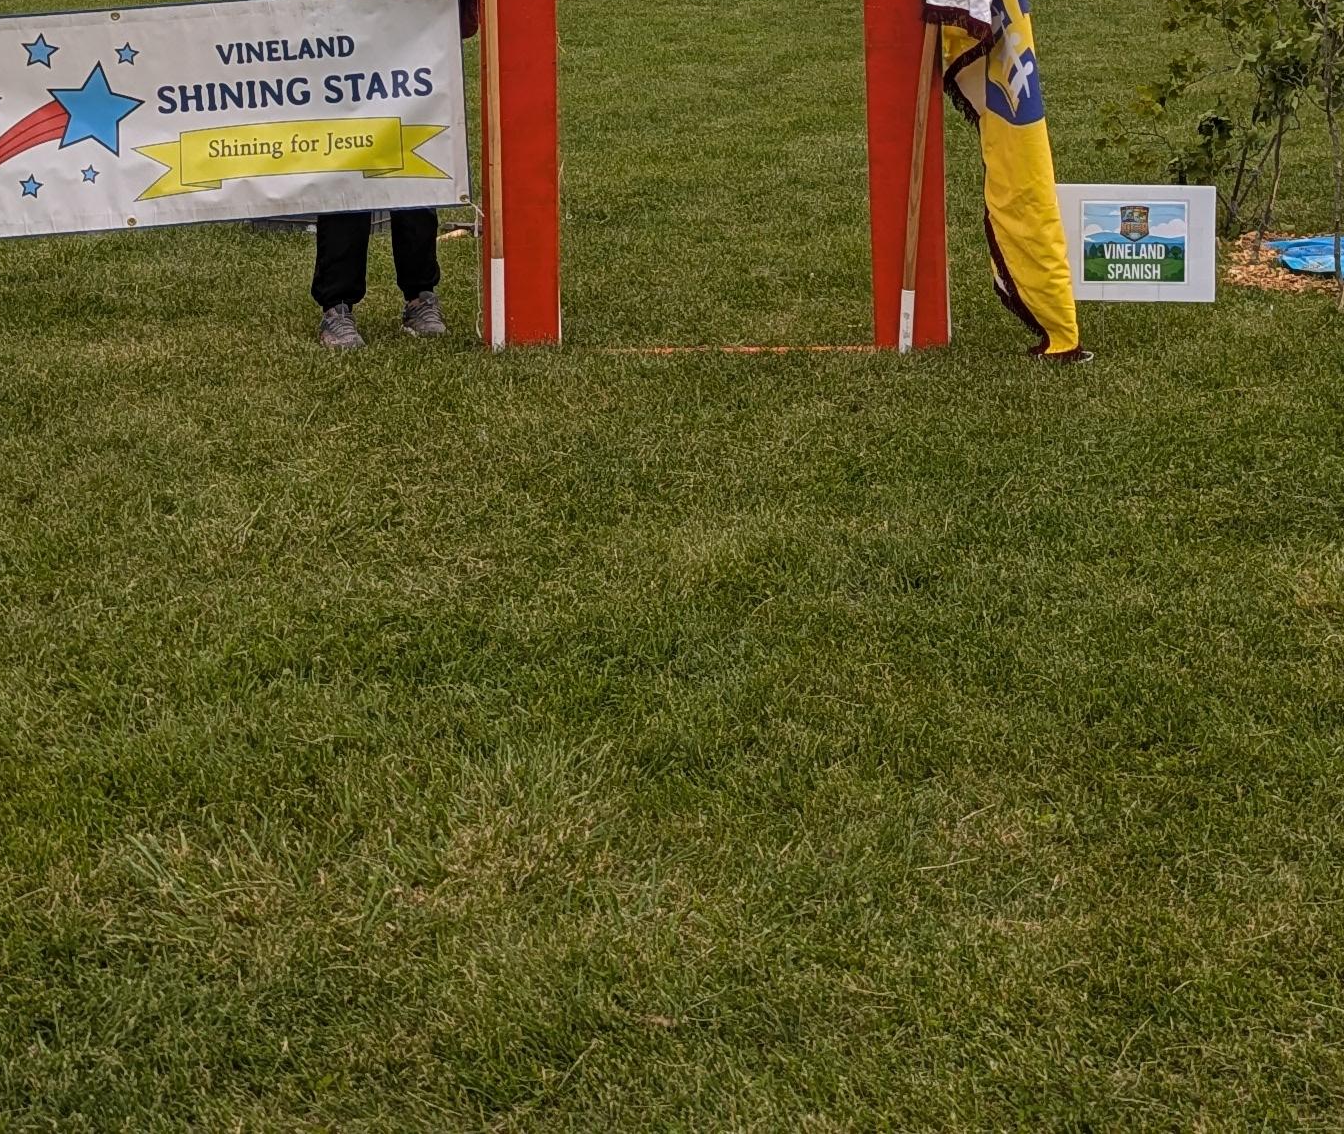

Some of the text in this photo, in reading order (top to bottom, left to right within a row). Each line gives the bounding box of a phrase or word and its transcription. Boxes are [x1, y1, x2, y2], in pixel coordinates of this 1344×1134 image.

[215, 35, 355, 65] VINELAND
[156, 67, 434, 115] SHINING STARS
[208, 132, 374, 159] Shining for Jesus
[1103, 243, 1165, 260] VINELAND
[1107, 263, 1161, 280] SPANISH
